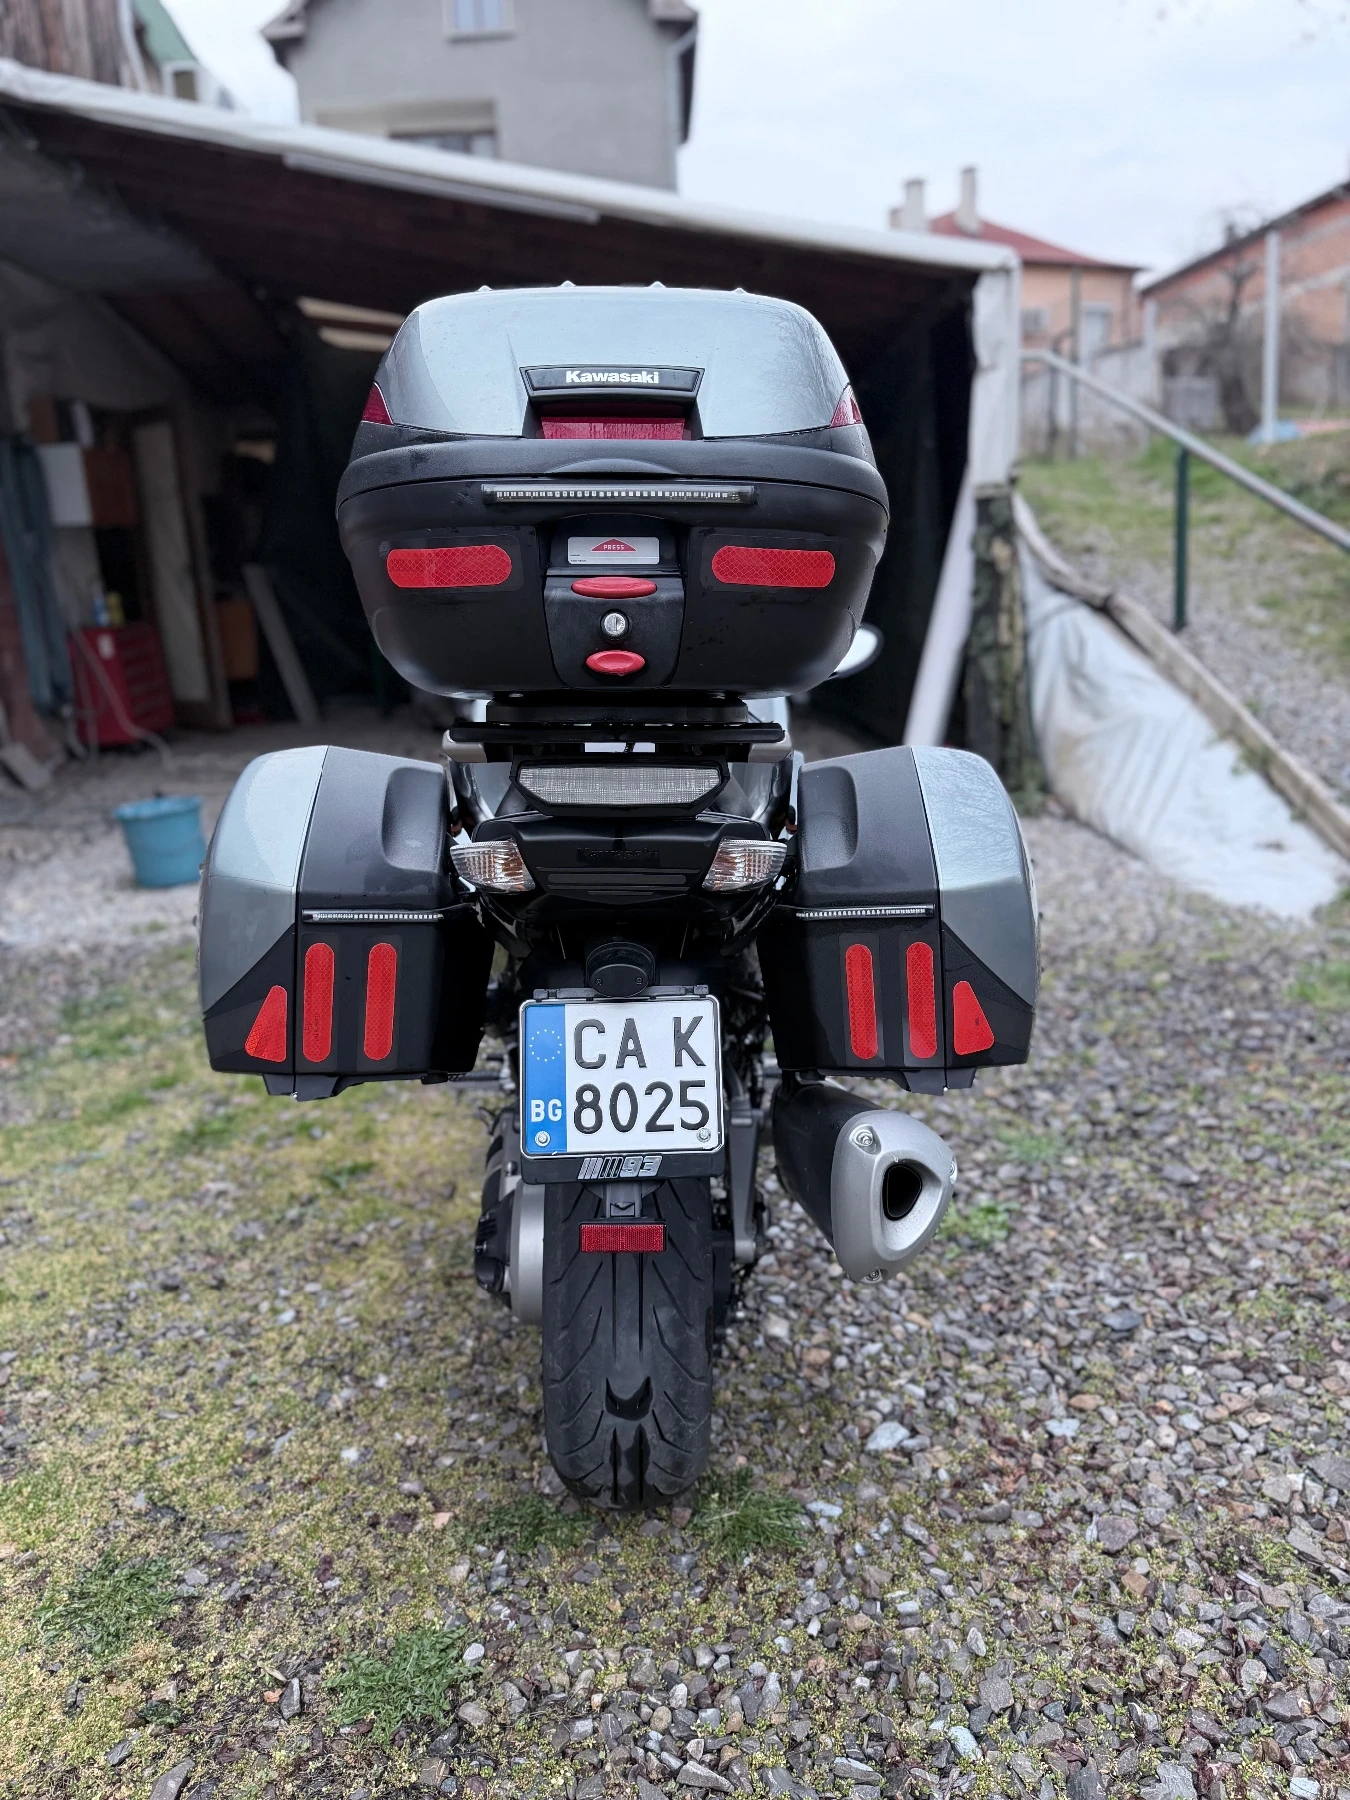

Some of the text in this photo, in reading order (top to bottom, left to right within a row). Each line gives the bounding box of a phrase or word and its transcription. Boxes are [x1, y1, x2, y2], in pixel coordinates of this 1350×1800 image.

[566, 371, 660, 384] Kawasaki
[574, 1016, 706, 1069] CA K
[530, 1098, 563, 1122] BG
[573, 1079, 710, 1135] 8025
